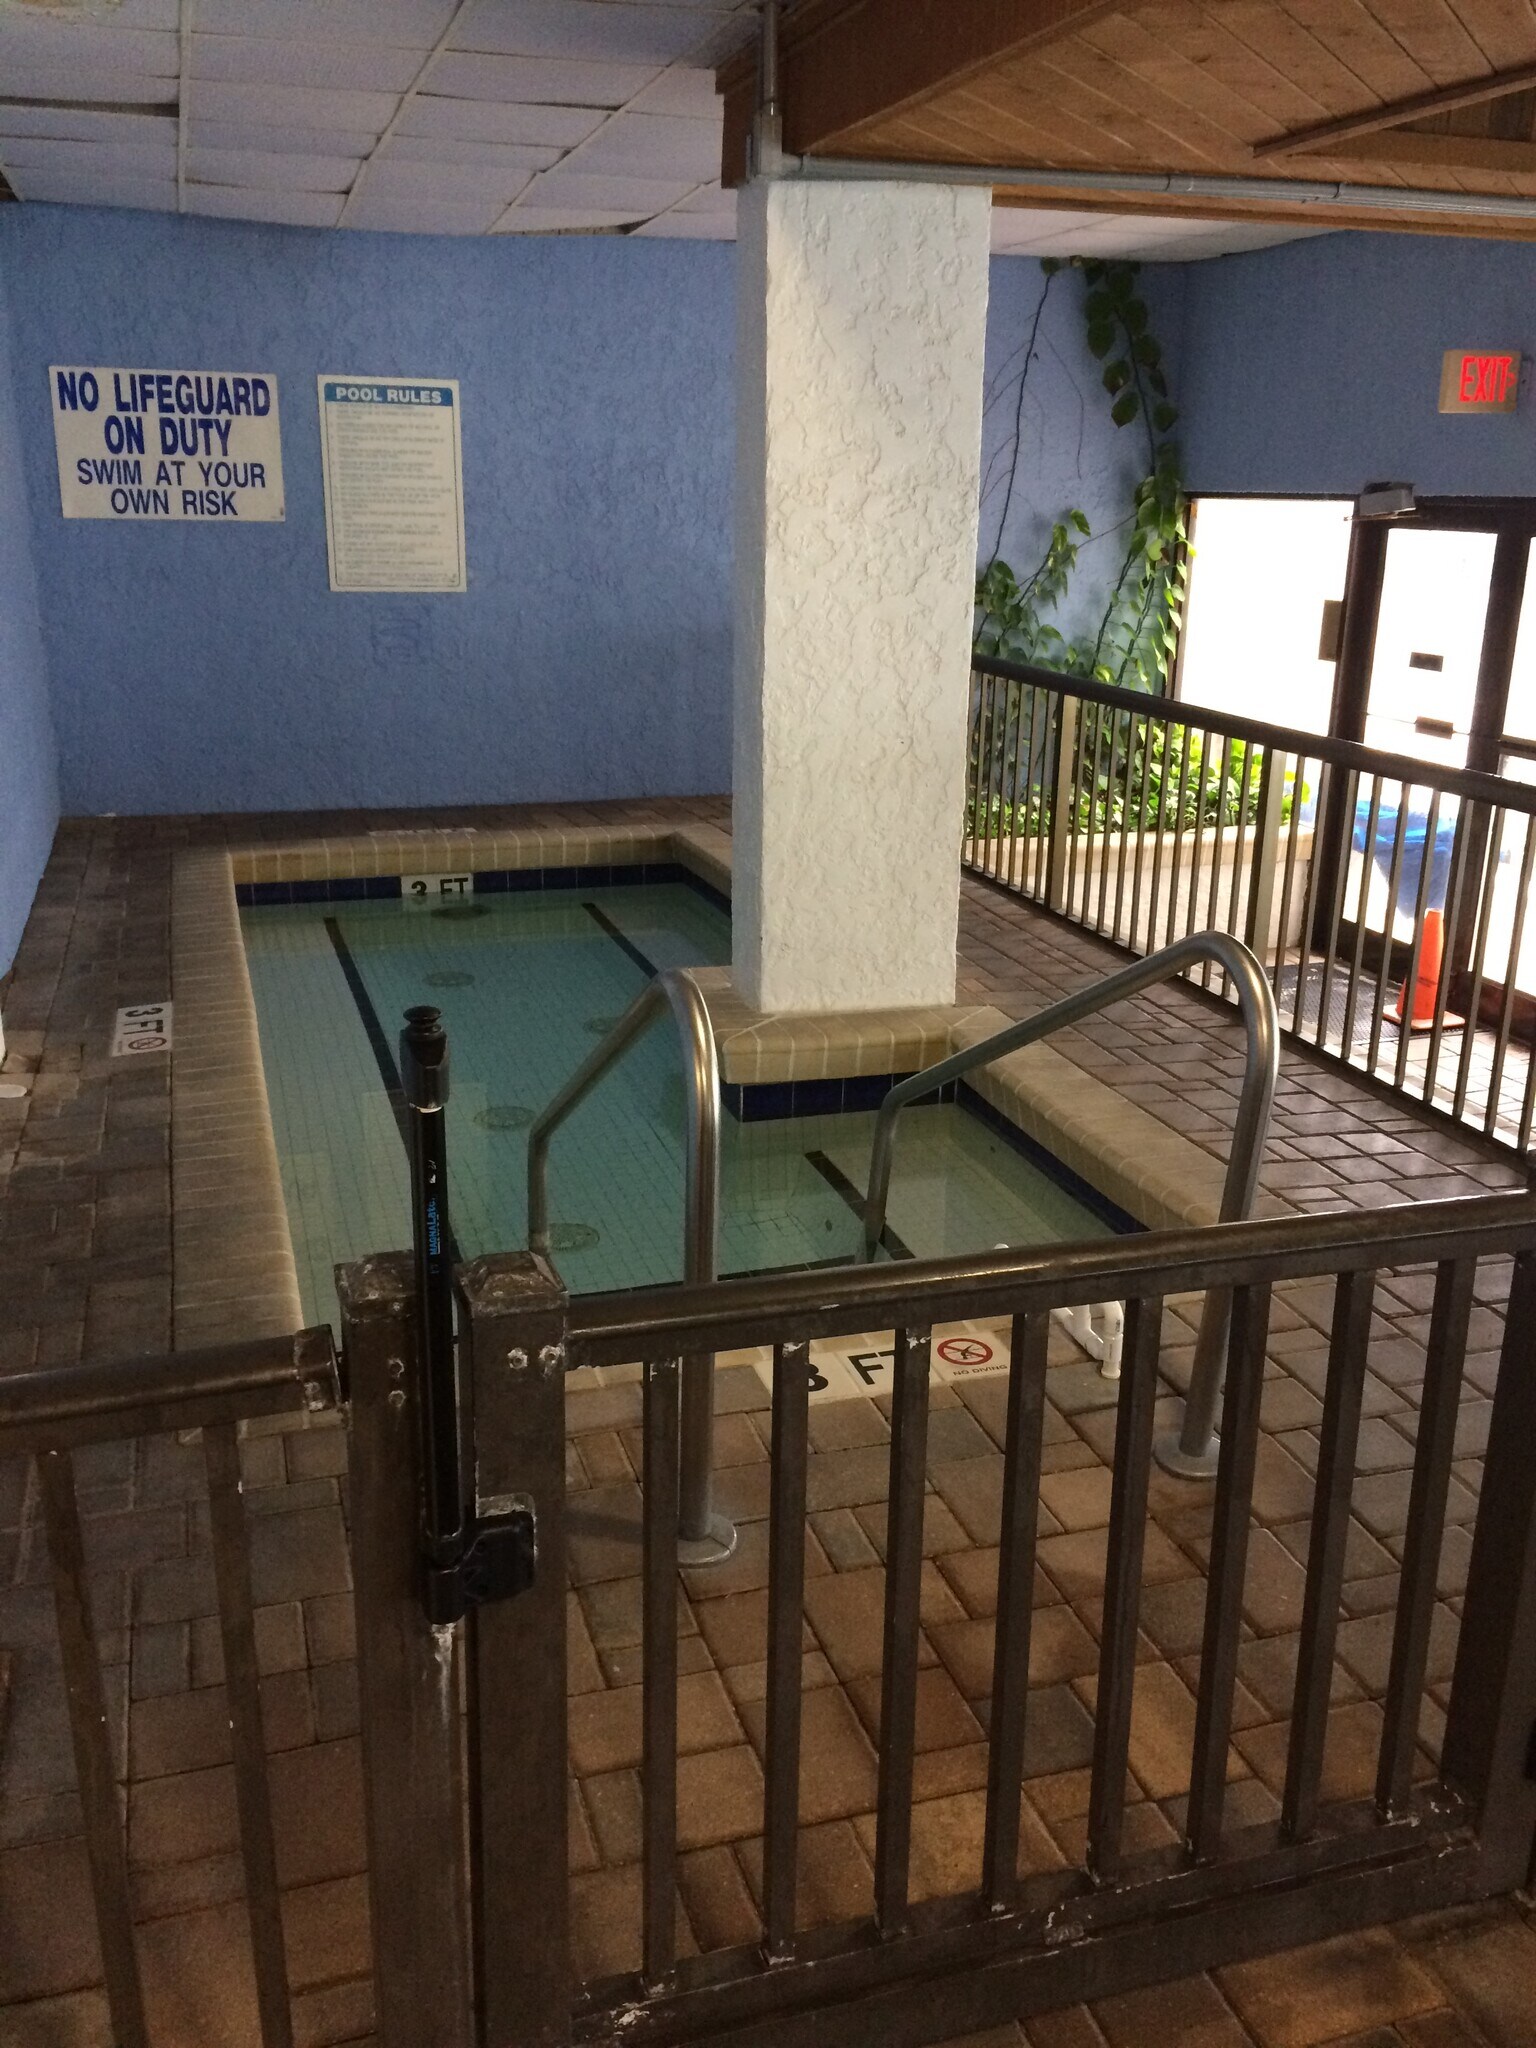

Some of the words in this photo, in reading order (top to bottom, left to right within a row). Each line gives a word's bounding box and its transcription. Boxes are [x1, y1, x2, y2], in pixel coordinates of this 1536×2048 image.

[1459, 355, 1512, 403] EXIT
[57, 371, 99, 412] NO
[113, 372, 271, 416] LIFEGUARD
[336, 387, 382, 401] POOL
[387, 389, 442, 404] RULES
[104, 415, 145, 454] ON
[159, 417, 232, 456] DUTY
[77, 458, 142, 485] SWIM
[156, 461, 186, 486] AT
[198, 461, 266, 488] YOUR
[111, 488, 170, 514] OWN
[182, 490, 238, 516] RISK
[125, 1007, 164, 1018] 3
[123, 1019, 164, 1035] FT
[972, 1364, 1008, 1374] DIVING
